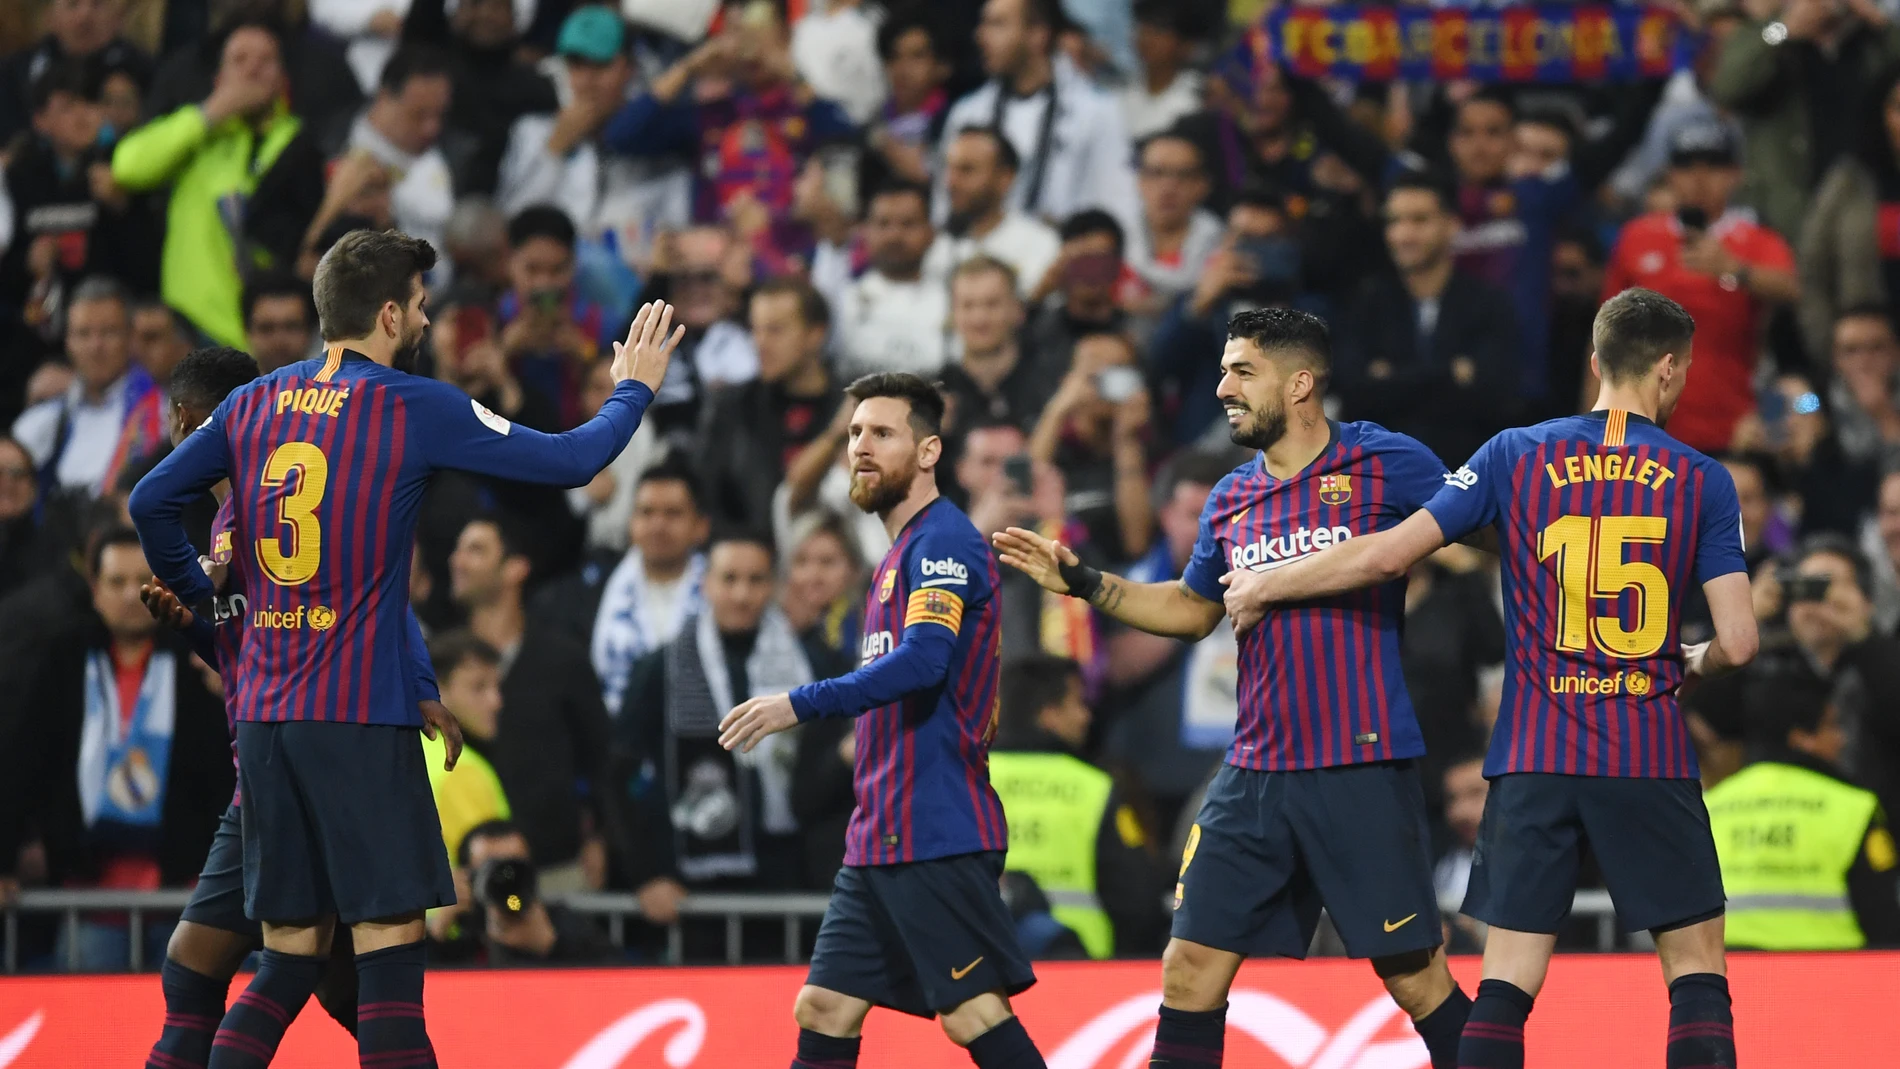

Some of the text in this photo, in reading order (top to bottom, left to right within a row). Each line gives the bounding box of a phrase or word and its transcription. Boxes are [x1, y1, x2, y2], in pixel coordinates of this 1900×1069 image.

[276, 388, 349, 418] PIQUÉ
[1545, 454, 1675, 491] LENGLET
[254, 441, 328, 586] 3
[1231, 525, 1352, 570] Rakuten
[921, 557, 968, 579] beko
[1537, 514, 1669, 659] 15
[254, 605, 305, 629] unicef
[1550, 670, 1623, 694] unicef
